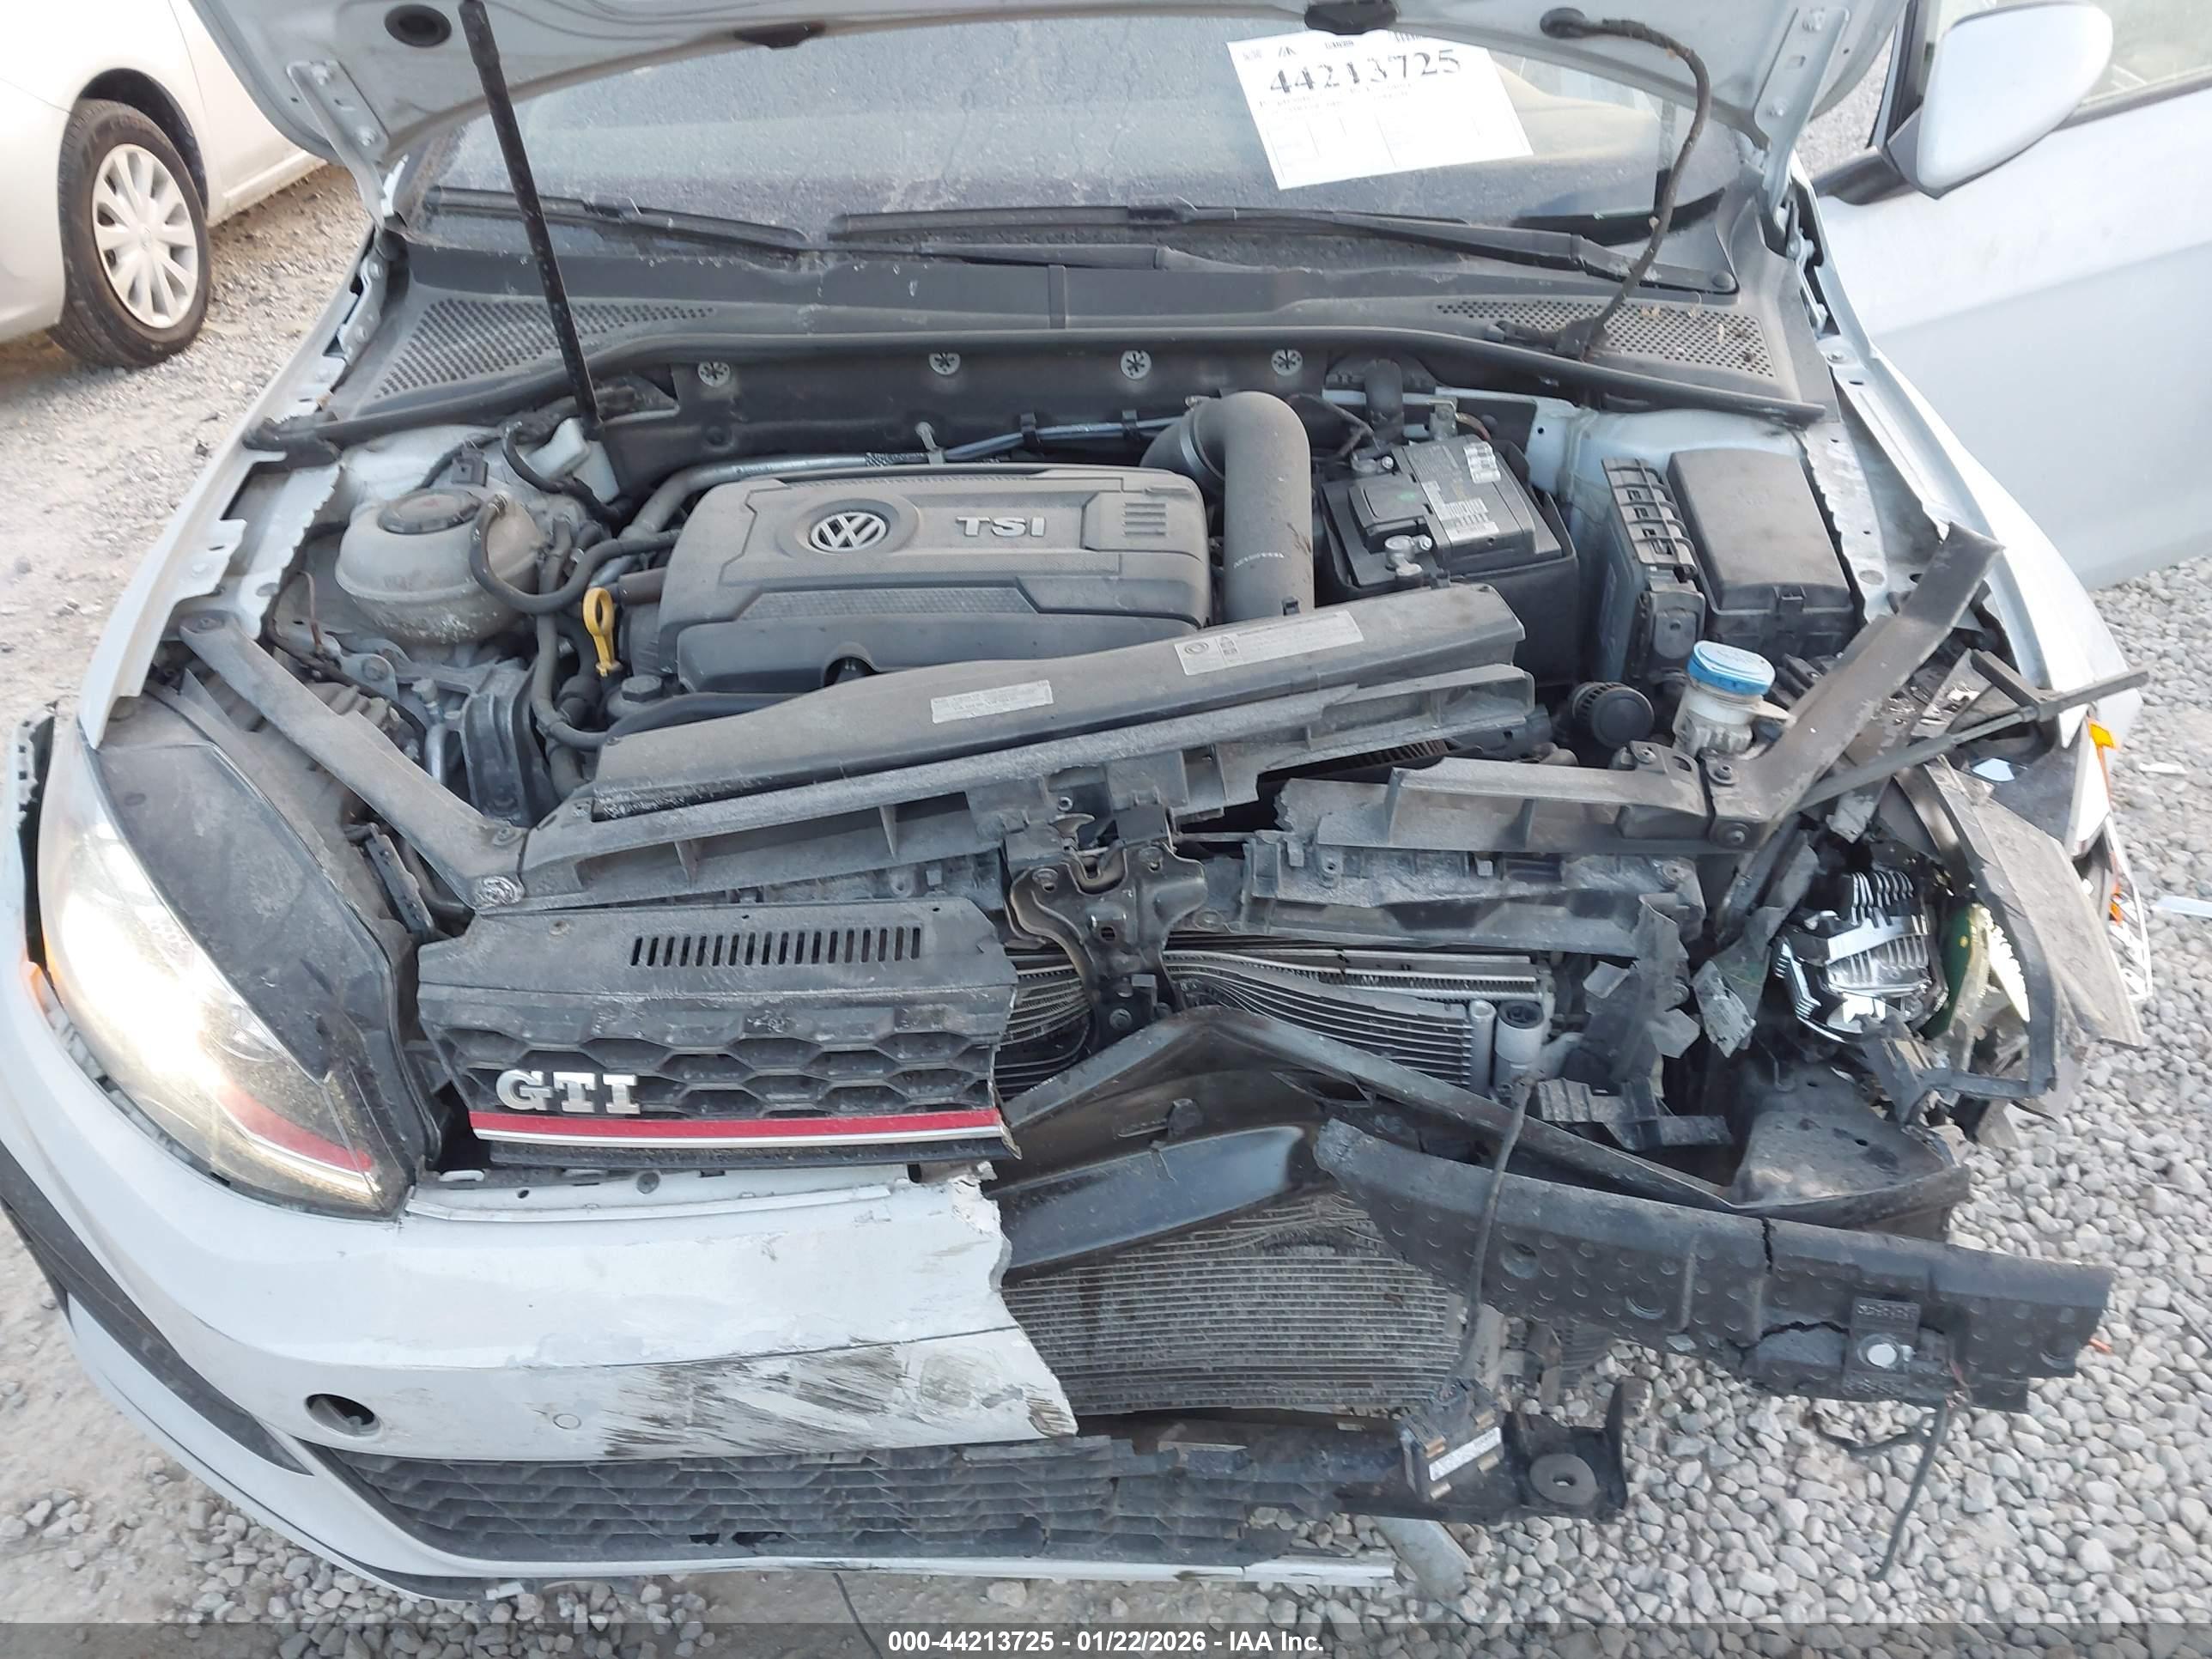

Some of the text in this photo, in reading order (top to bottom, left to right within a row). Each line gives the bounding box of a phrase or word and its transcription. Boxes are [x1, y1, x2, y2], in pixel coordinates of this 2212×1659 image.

[1270, 48, 1462, 94] 44213725
[956, 516, 1047, 538] TSI
[495, 1069, 641, 1115] GTI
